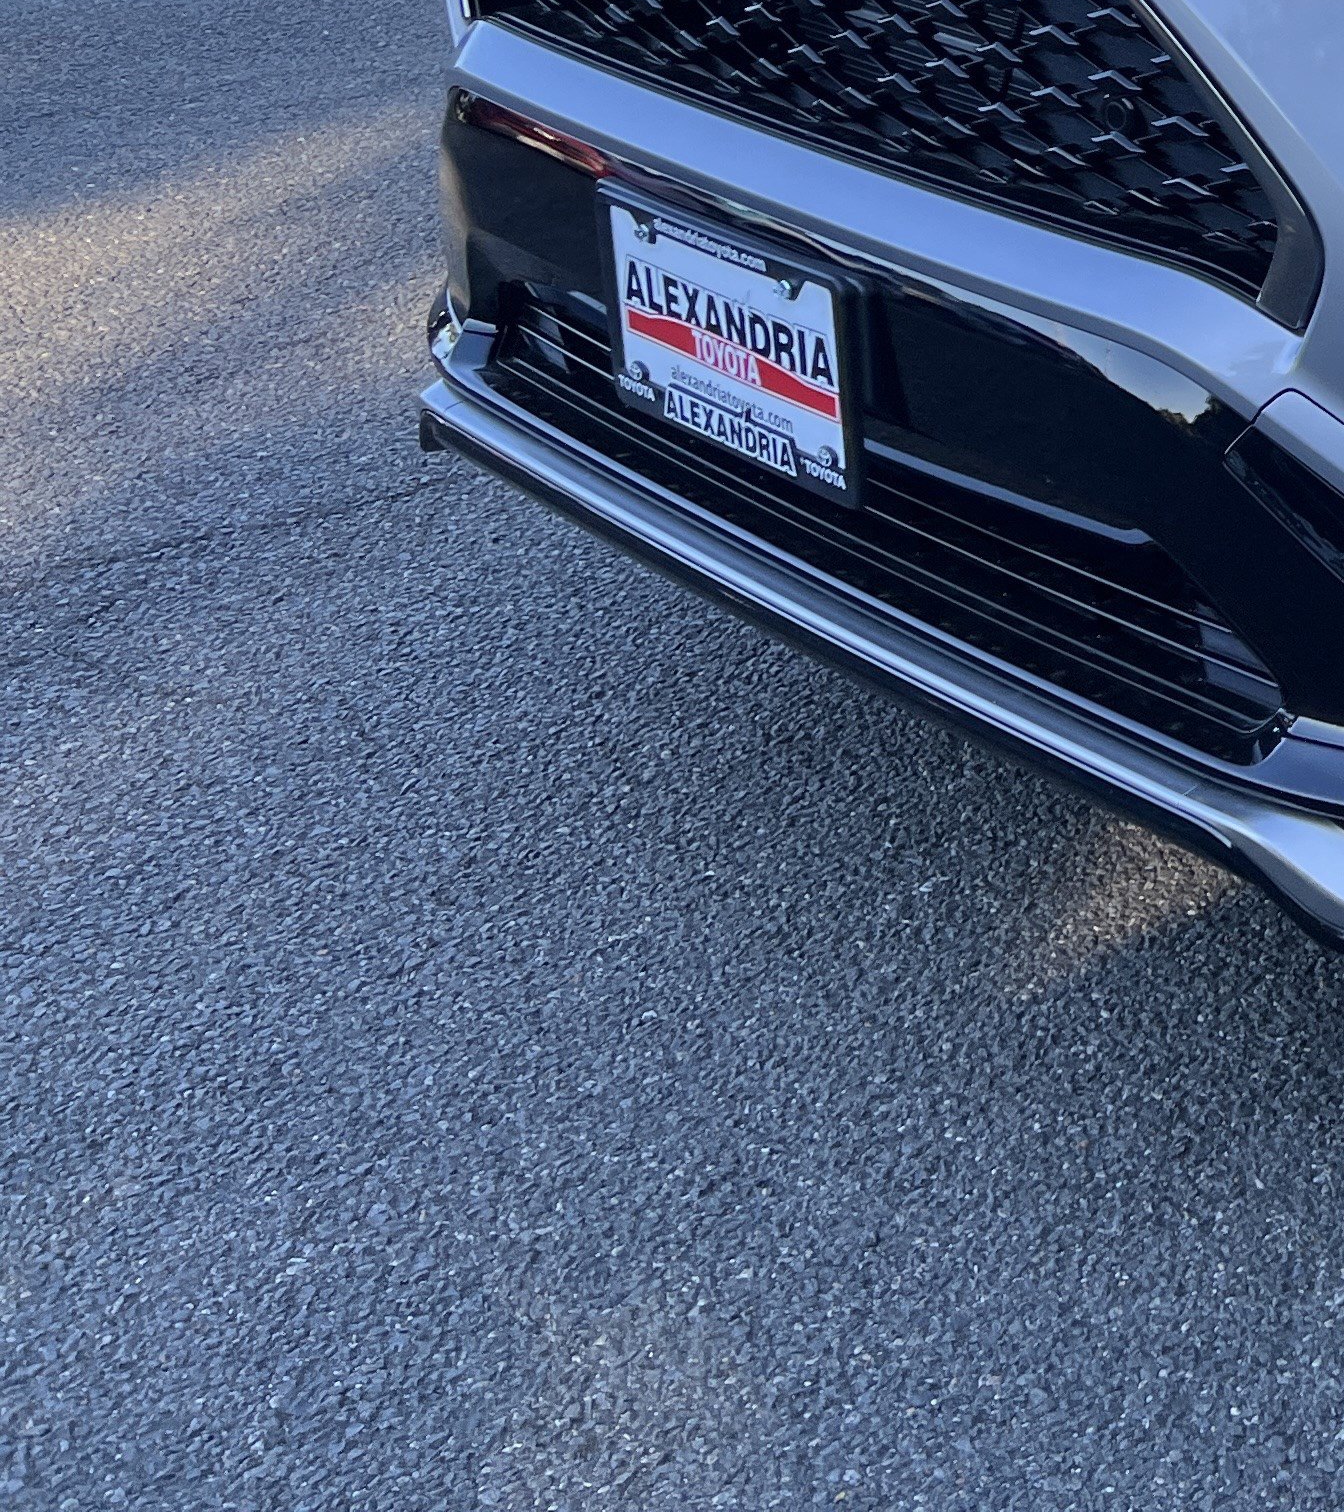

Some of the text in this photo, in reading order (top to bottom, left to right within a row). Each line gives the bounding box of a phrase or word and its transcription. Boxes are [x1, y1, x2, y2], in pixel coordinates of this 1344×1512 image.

[625, 259, 834, 387] ALEXANDRIA
[691, 328, 762, 387] TOYOTA
[618, 373, 655, 402] TOYOTA
[665, 388, 797, 476] ALEXANDRIA
[803, 459, 847, 490] TOYOTA
